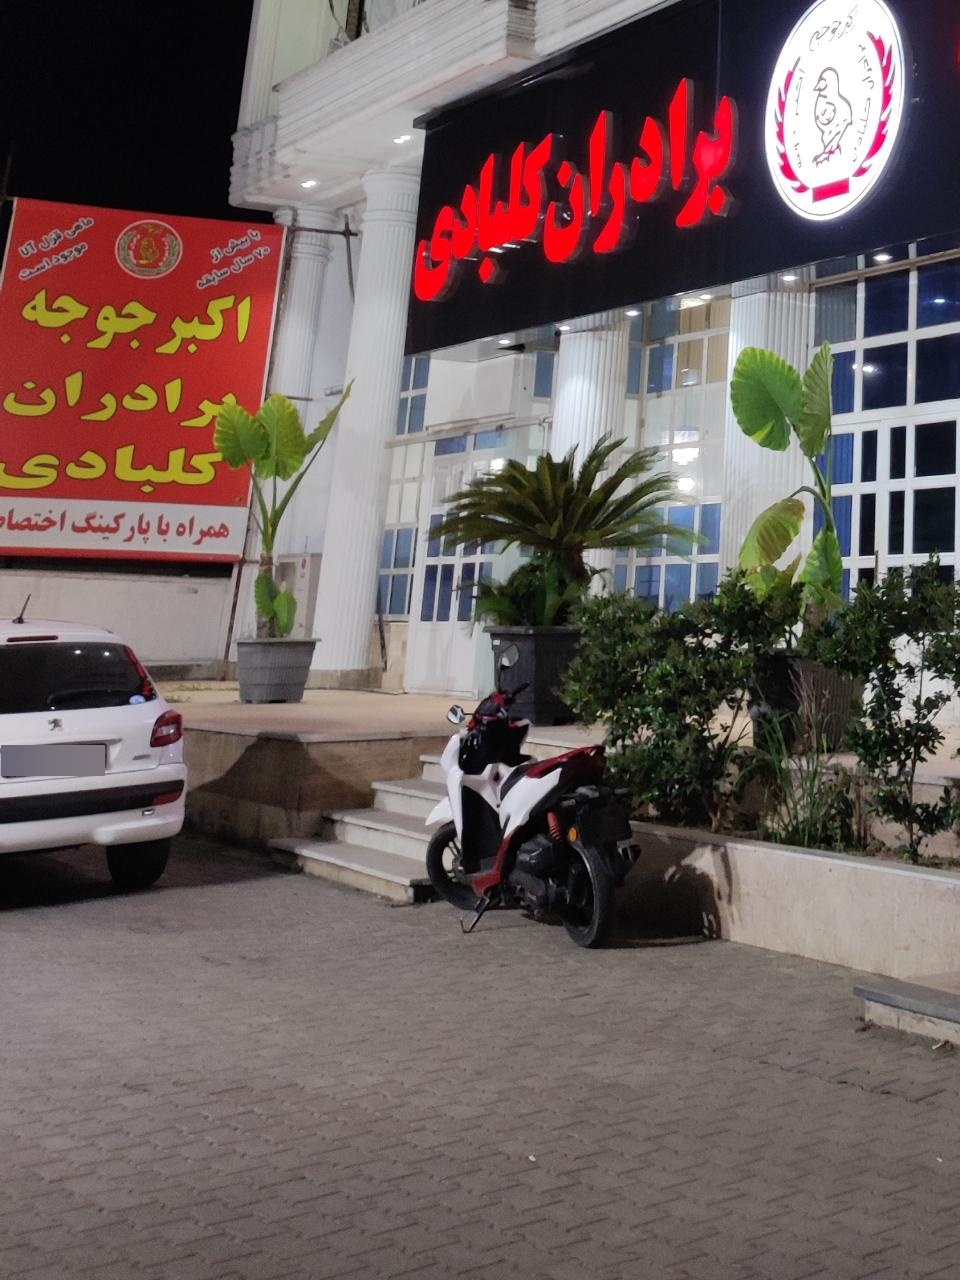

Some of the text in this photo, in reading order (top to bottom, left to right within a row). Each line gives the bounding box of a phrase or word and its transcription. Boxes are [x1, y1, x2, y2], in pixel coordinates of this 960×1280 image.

[543, 77, 737, 264] برادران
[65, 218, 94, 238] ماهی
[19, 243, 87, 280] موجود است
[211, 230, 261, 263] با بیش از
[197, 268, 230, 289] سابقه
[231, 256, 254, 274] سال
[20, 288, 252, 355] اکبر جوجه
[71, 511, 151, 544] پارکینگ
[157, 513, 170, 543] با
[175, 514, 230, 546] همراه
